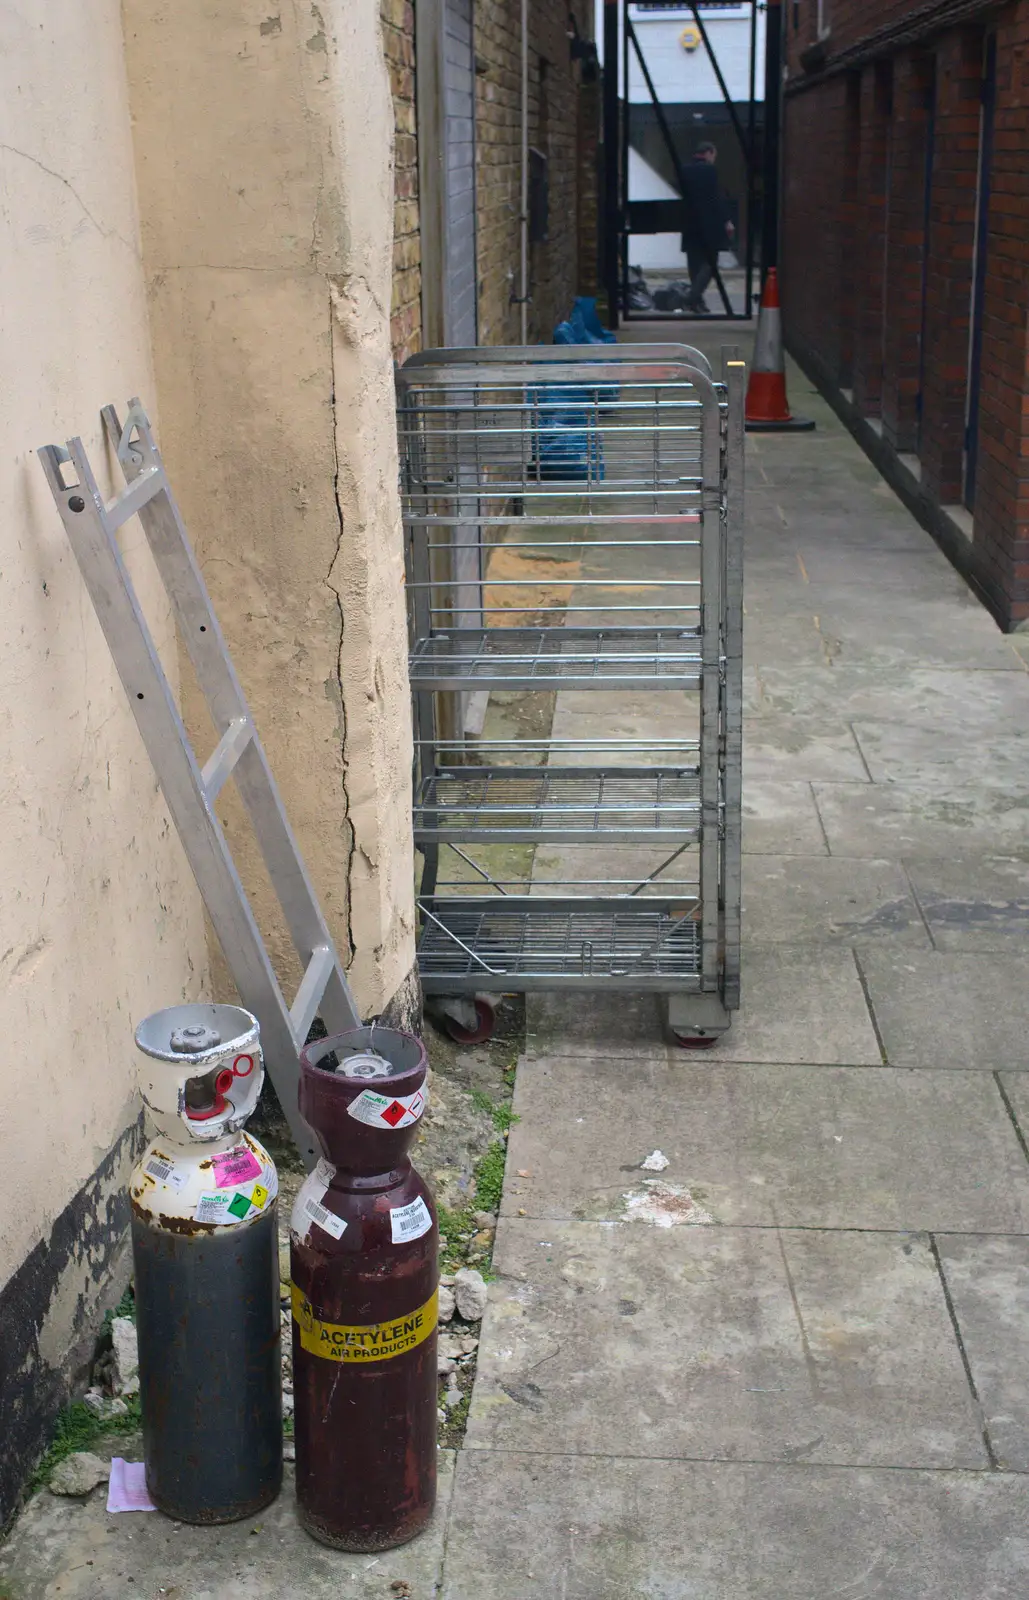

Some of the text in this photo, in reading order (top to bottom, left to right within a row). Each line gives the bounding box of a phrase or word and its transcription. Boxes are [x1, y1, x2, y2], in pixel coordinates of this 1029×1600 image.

[320, 1313, 424, 1346] ACETYLENE
[330, 1334, 417, 1358] AIR PRODUCTS
